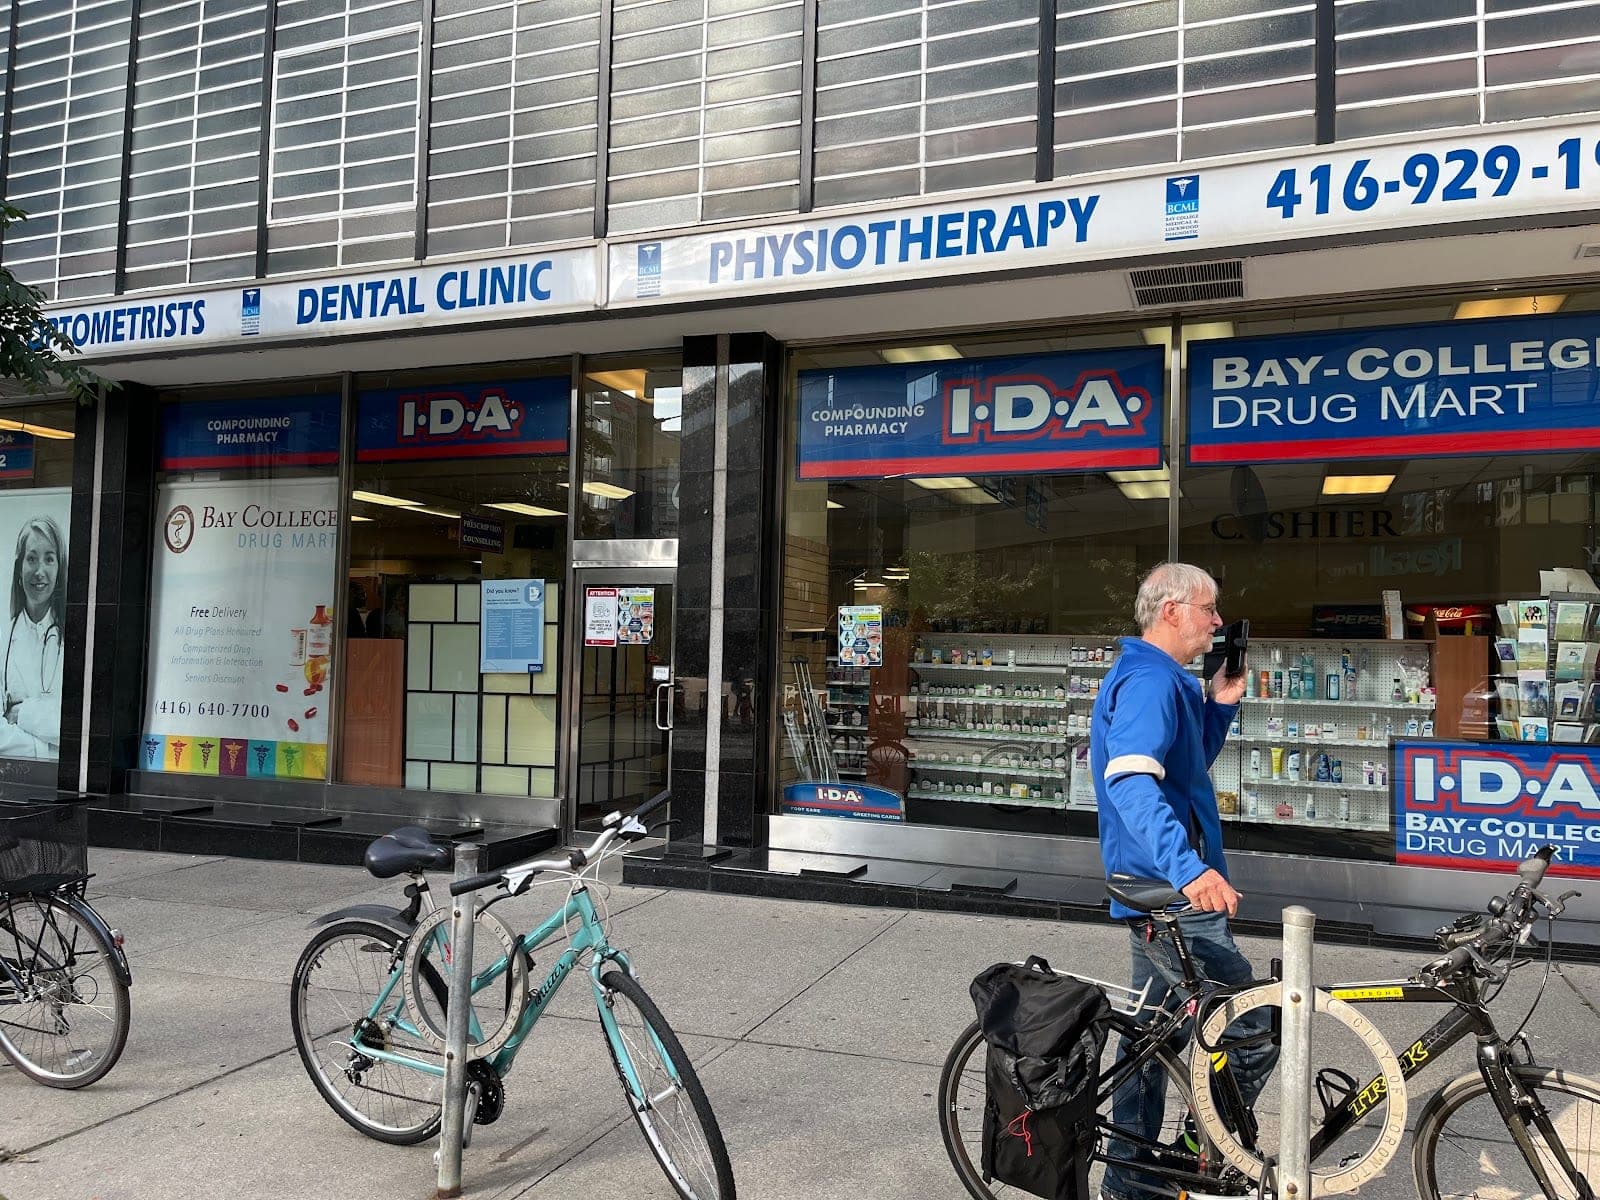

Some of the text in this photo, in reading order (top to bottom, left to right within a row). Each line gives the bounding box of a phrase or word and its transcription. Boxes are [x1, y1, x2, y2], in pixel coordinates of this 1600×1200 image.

[1266, 137, 1600, 219] 416-929-1
[1167, 201, 1198, 214] BCML
[709, 194, 1099, 284] PHYSIOTHERAPY
[296, 260, 553, 325] DENTAL CLINIC
[1212, 337, 1600, 391] BAY-COLLEG
[811, 404, 925, 423] COMPOUNDING
[1212, 382, 1538, 430] DRUG MART
[207, 416, 291, 431] COMPOUNDING
[824, 422, 909, 438] PHARMACY
[216, 431, 278, 445] PHARMACY
[201, 504, 338, 529] BAY COLLEGE
[1210, 510, 1400, 540] CSHIER
[238, 532, 337, 549] DRUG MART
[190, 606, 248, 620] Free Delivery
[1334, 614, 1385, 625] PEPS
[155, 700, 270, 719] (416) 640-7700
[1406, 832, 1580, 862] DRUG MART
[1348, 1041, 1428, 1116] TRK
[1350, 1017, 1404, 1183] CITY OF TORONTO
